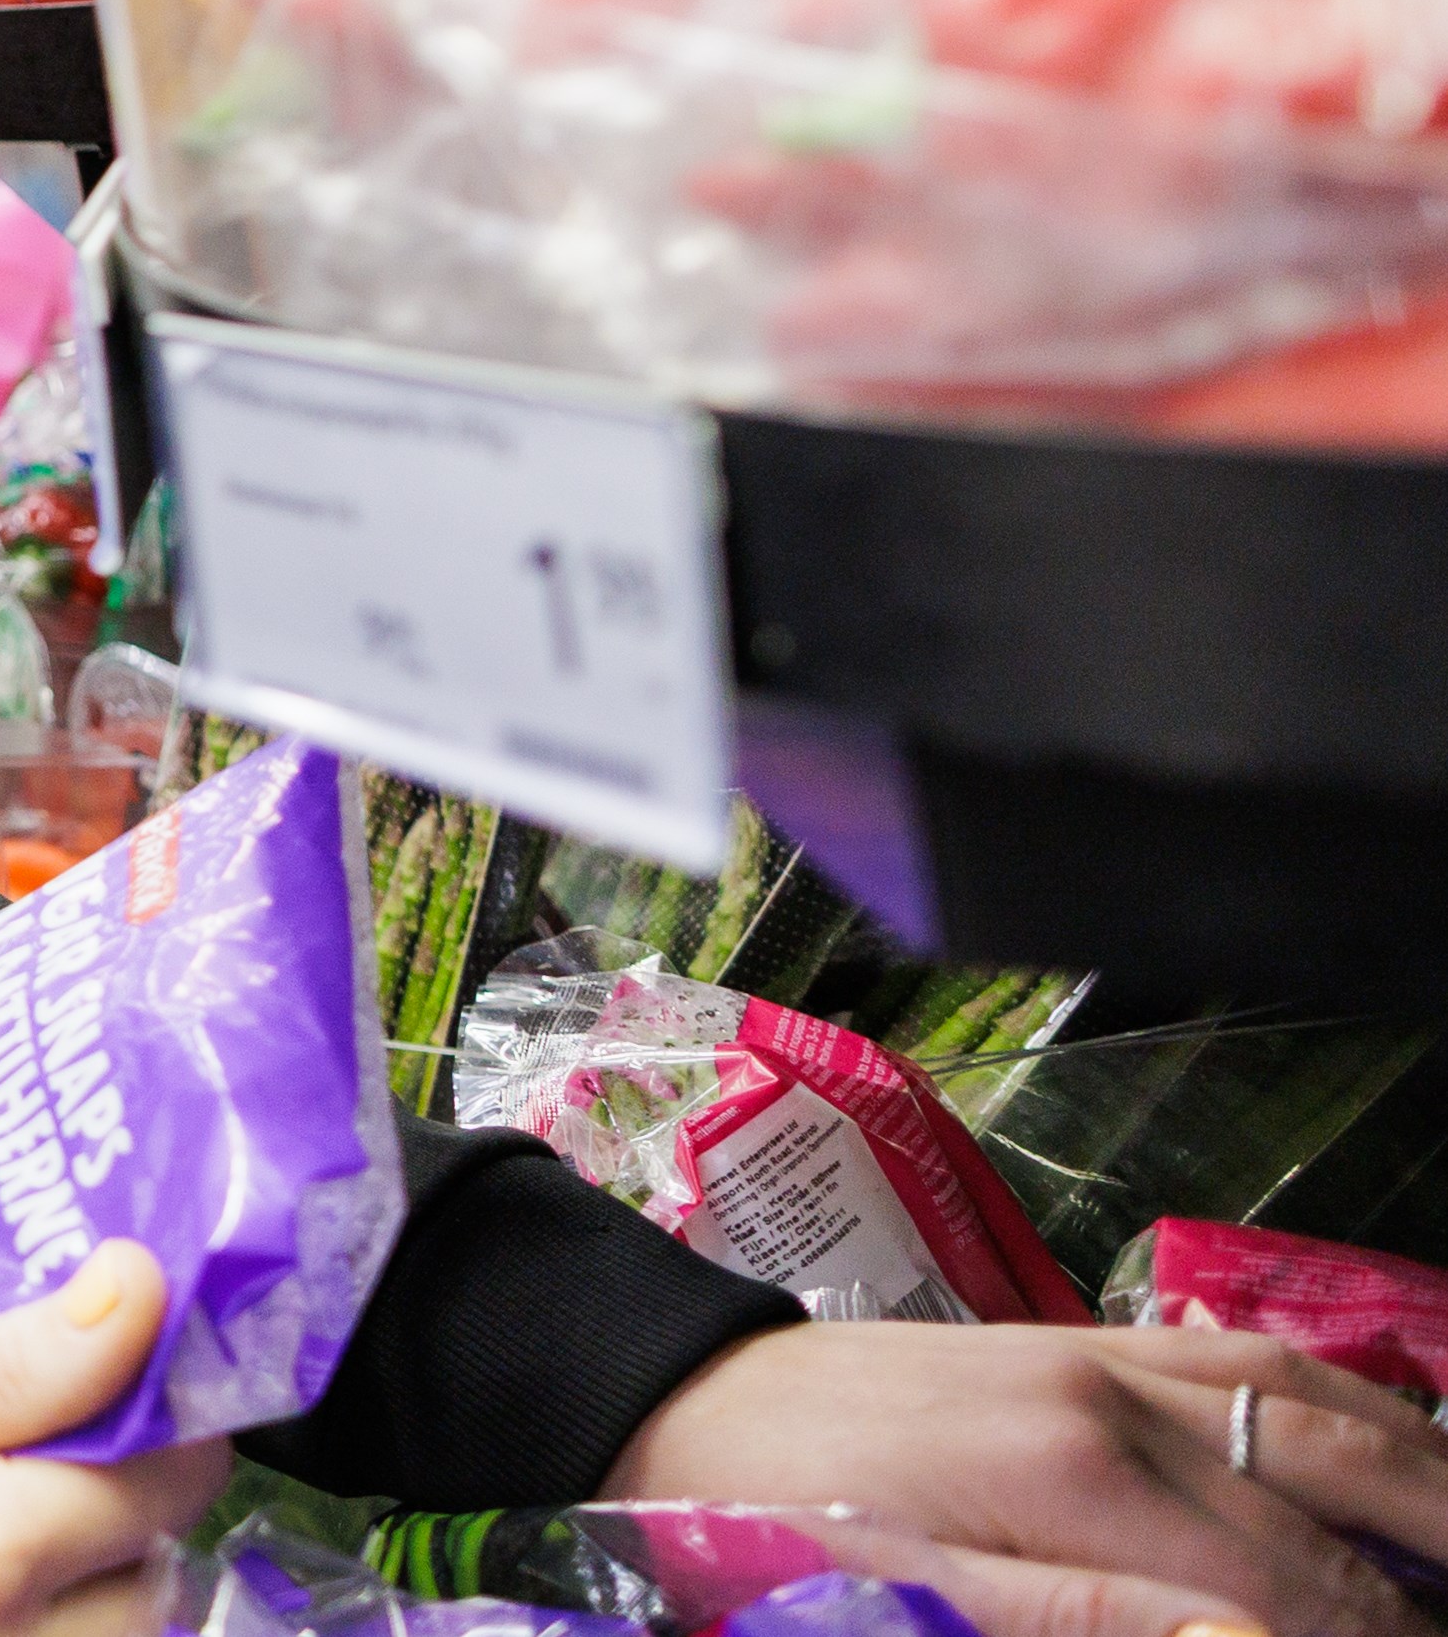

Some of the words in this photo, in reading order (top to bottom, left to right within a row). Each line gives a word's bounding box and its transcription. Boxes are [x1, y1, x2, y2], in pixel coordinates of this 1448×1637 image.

[34, 978, 133, 1188] SNAPS
[740, 1133, 785, 1170] Enterprises
[784, 1119, 799, 1134] Ltd
[706, 1183, 744, 1210] Airport
[745, 1164, 771, 1185] North
[793, 1125, 818, 1147] Nairobi
[760, 1175, 779, 1191] Origin
[768, 1184, 798, 1207] Kenya
[776, 1215, 799, 1232] fine
[804, 1196, 822, 1211] fein
[763, 1209, 784, 1225] Size
[756, 1259, 780, 1276] Lot
[783, 1238, 812, 1260] code
